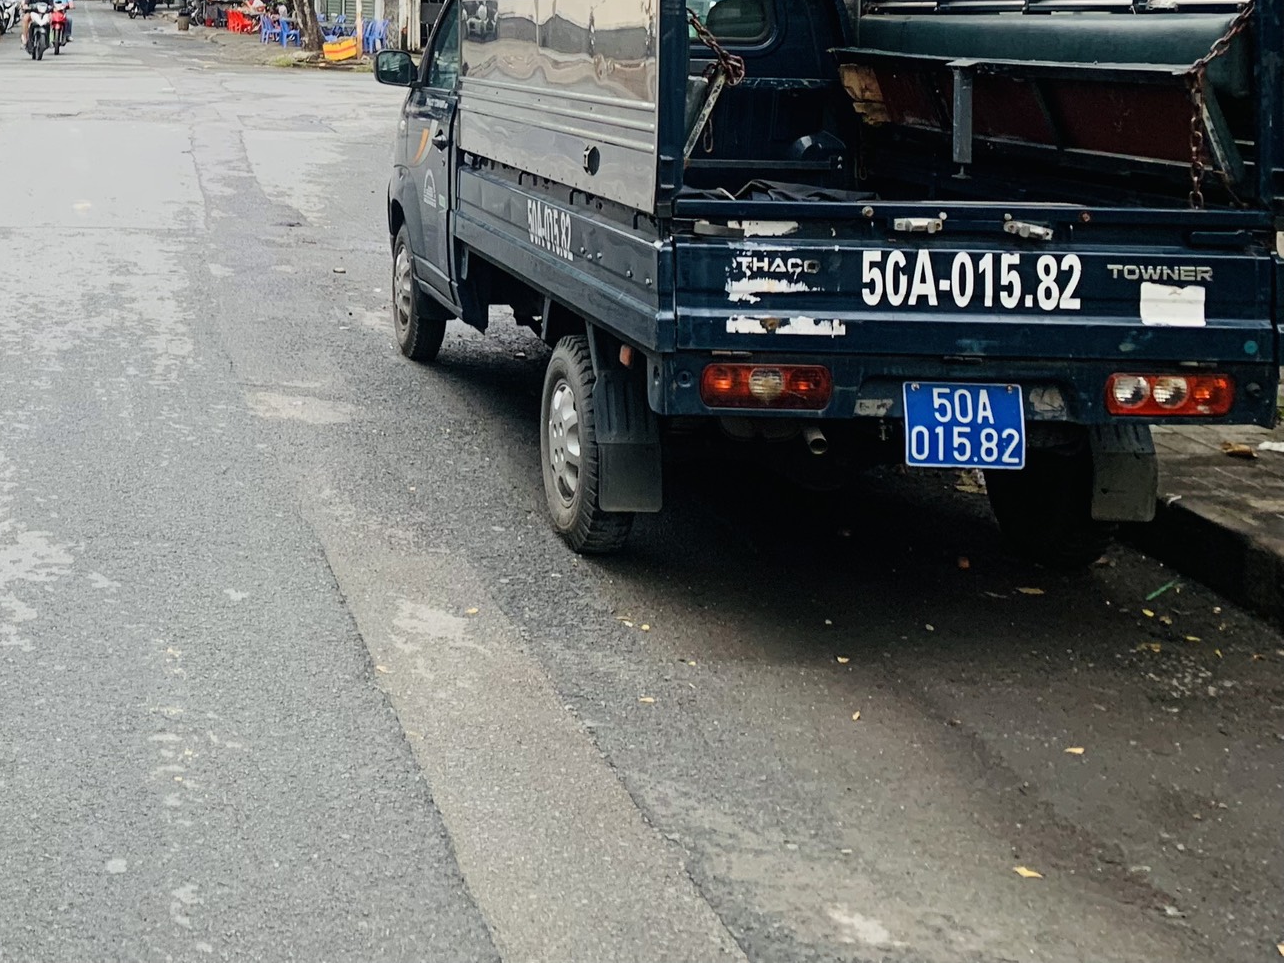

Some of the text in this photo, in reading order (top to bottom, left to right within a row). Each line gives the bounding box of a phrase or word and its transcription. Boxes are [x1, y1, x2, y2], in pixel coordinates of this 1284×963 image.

[527, 199, 574, 262] 50A-015.82
[736, 256, 821, 274] THACO
[861, 249, 1082, 311] 50A-015.82
[1106, 263, 1214, 282] TOWNER
[932, 387, 995, 424] 50A
[911, 425, 1020, 463] 015.82
